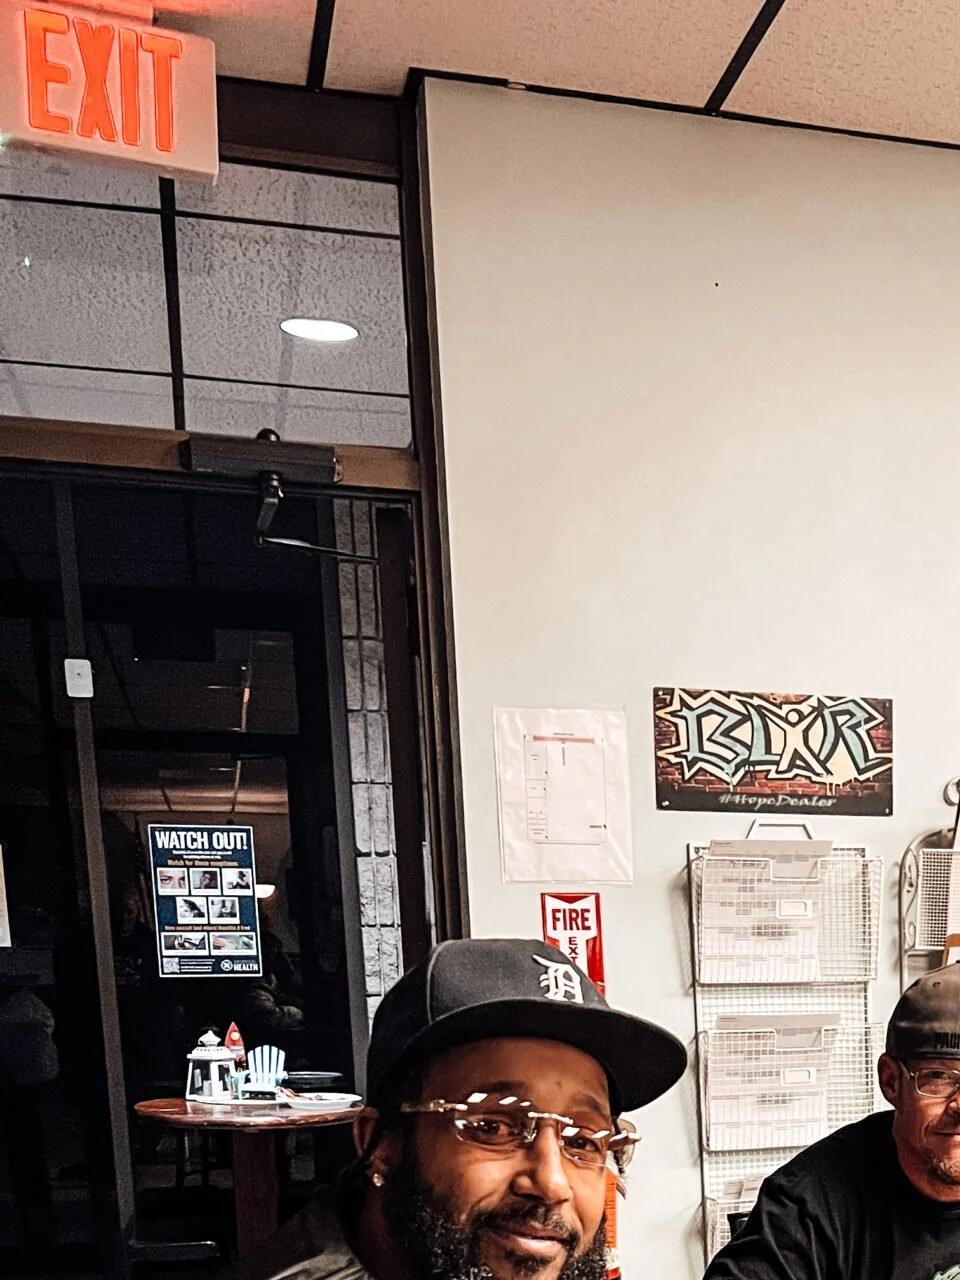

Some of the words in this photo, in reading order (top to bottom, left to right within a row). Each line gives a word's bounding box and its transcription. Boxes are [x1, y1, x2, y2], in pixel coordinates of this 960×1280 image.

[24, 8, 183, 152] EXIT
[719, 793, 837, 811] #HopeDealer
[155, 831, 209, 849] WATCH
[212, 832, 248, 850] OUT!
[551, 908, 592, 931] FIRE
[233, 963, 259, 972] HEALTH
[532, 954, 584, 1004] D
